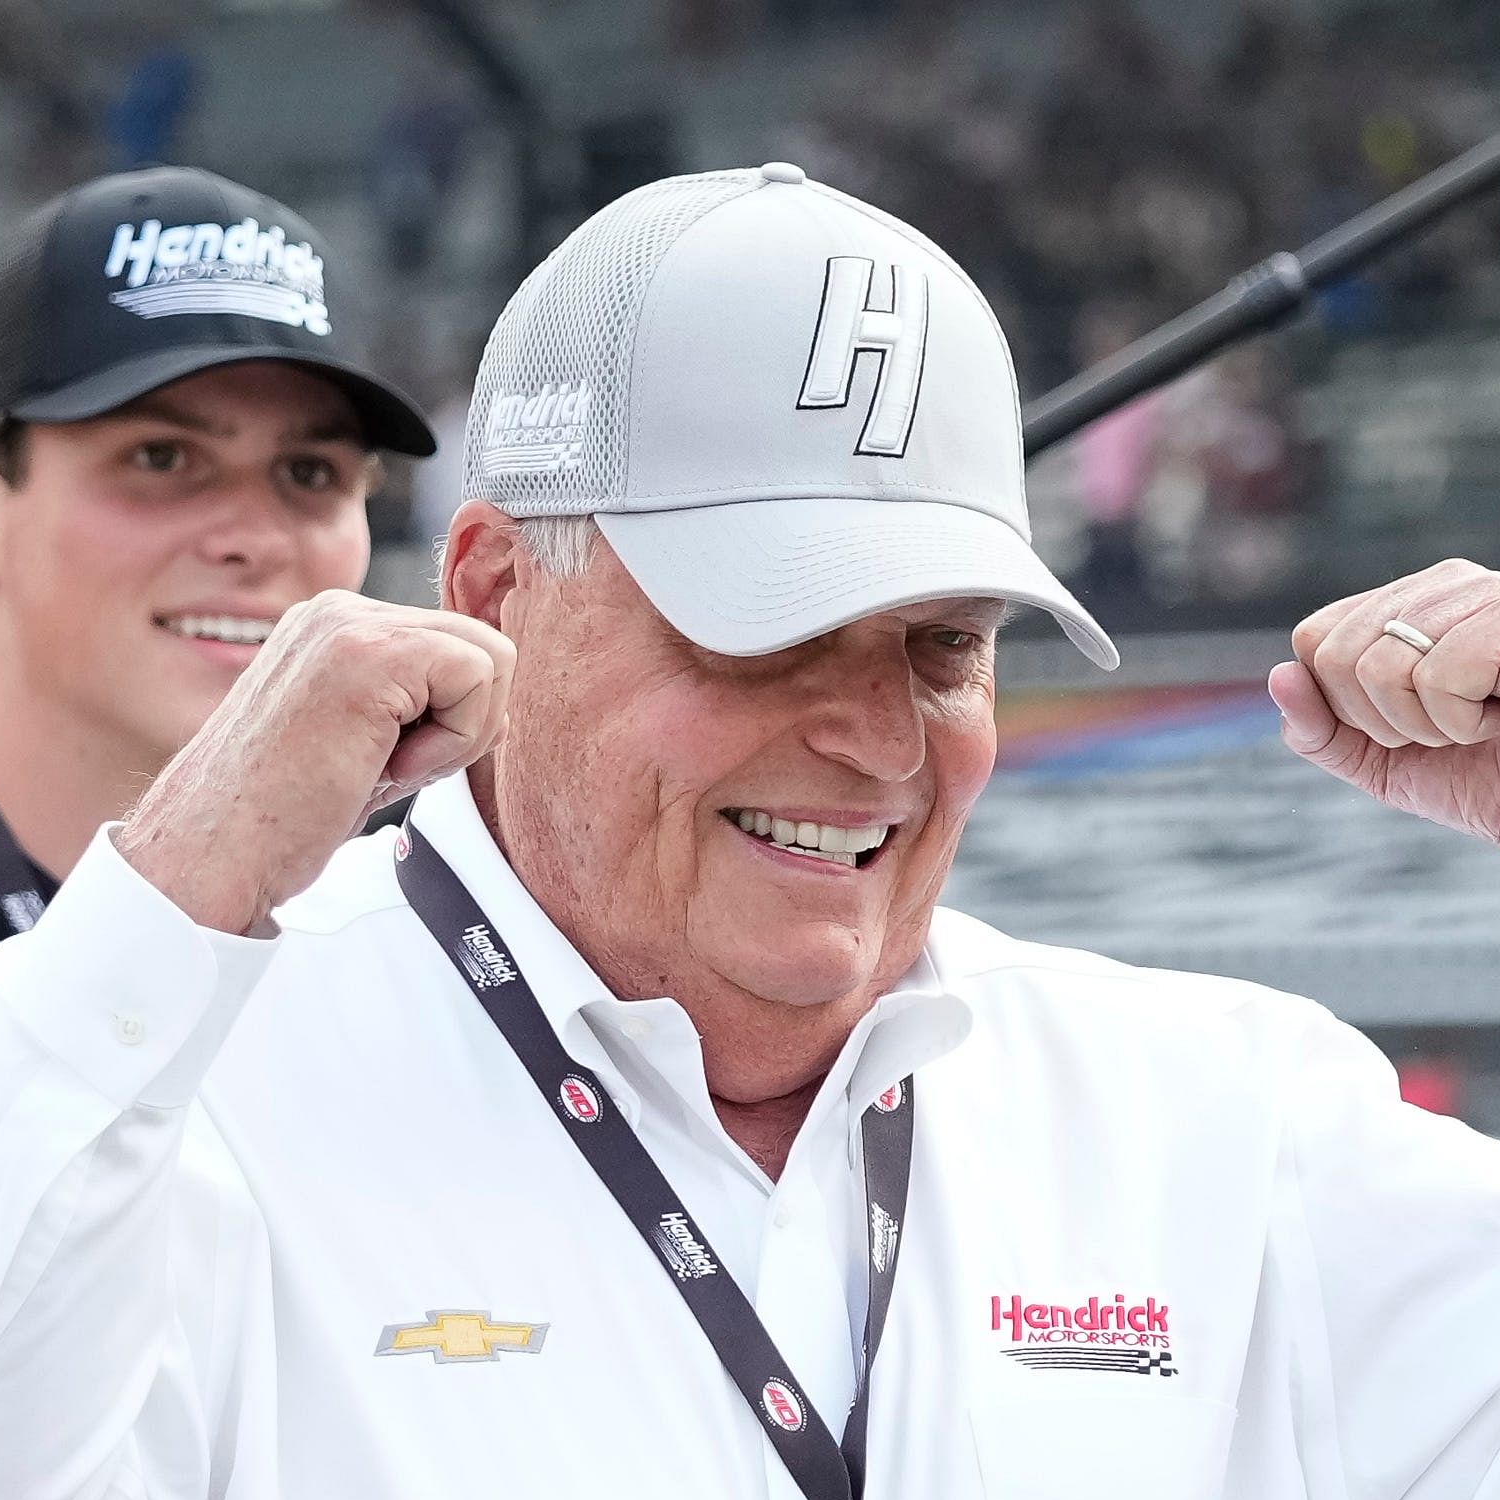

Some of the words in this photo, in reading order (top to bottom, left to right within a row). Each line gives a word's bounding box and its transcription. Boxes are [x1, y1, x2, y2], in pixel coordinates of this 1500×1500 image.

[104, 217, 325, 289] Hendrick
[462, 924, 517, 982] Hendrick
[660, 1212, 718, 1276] Hendrick
[990, 1294, 1169, 1342] Hendrick
[1027, 1329, 1170, 1349] MOTORSPORTS
